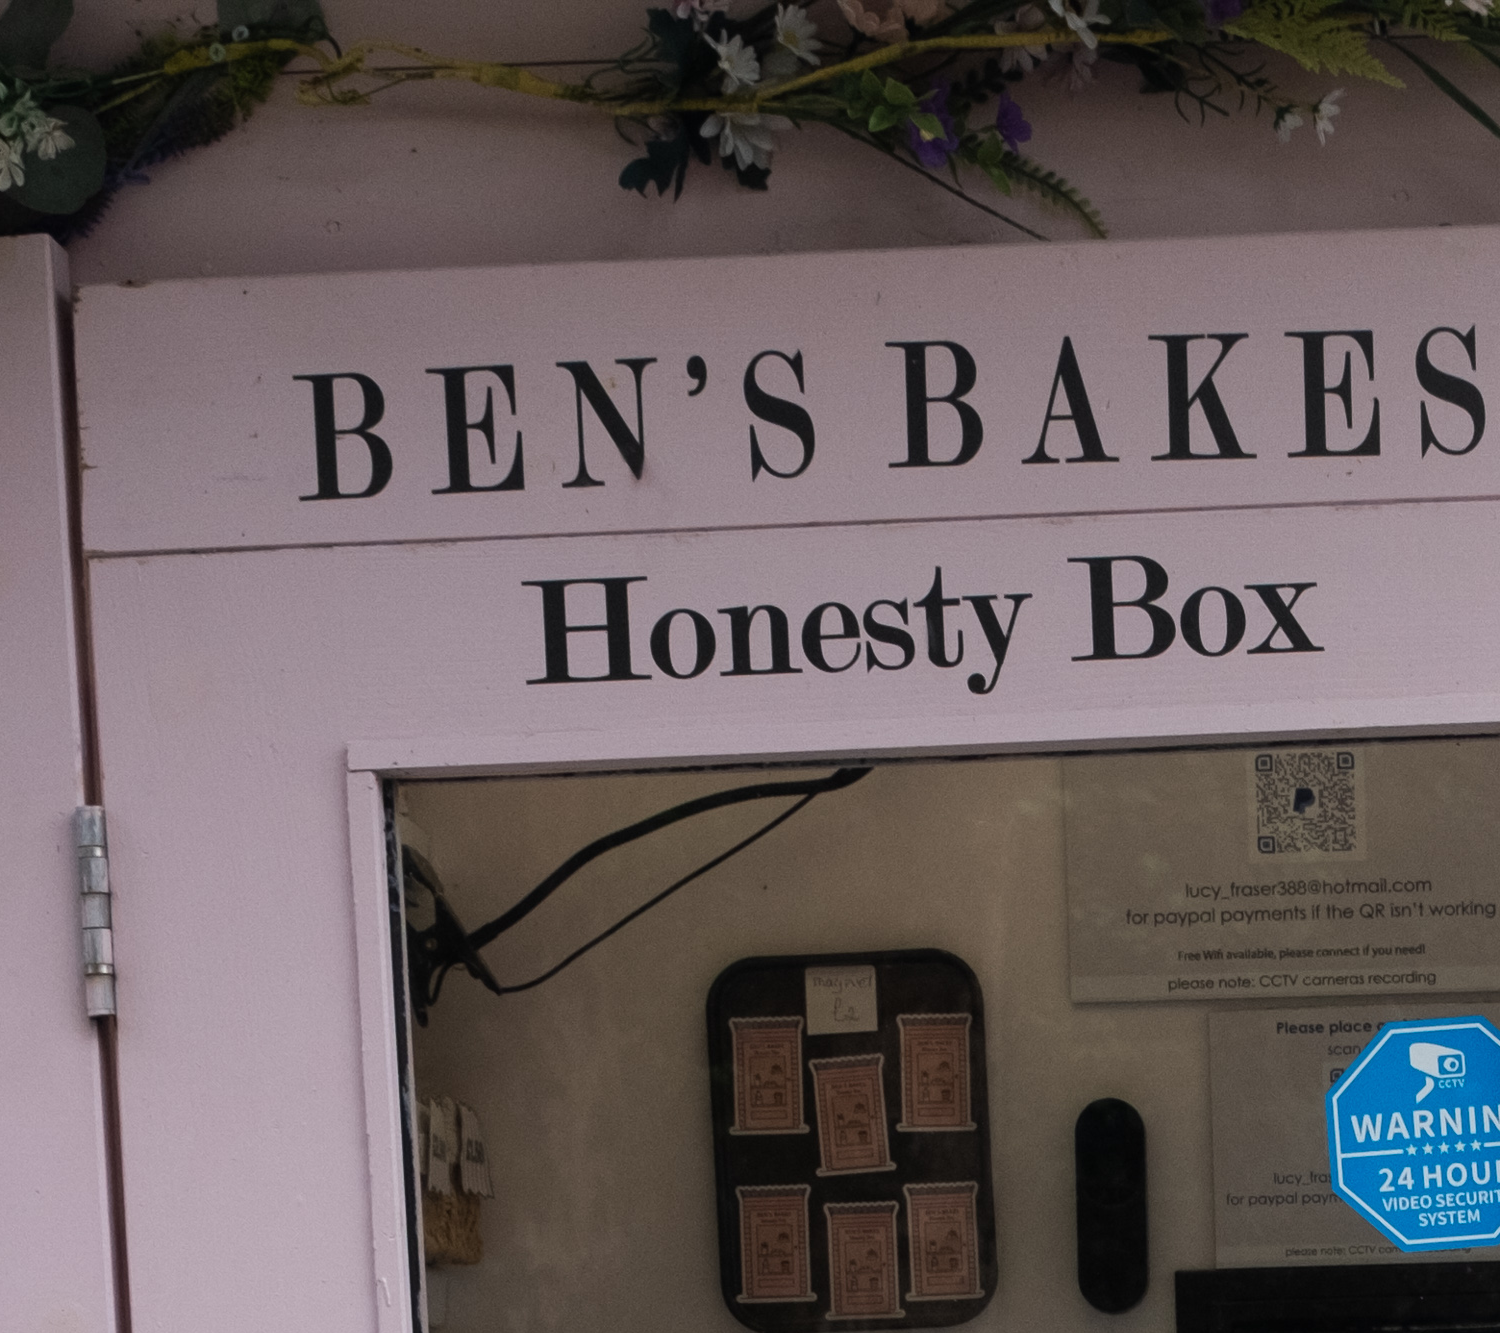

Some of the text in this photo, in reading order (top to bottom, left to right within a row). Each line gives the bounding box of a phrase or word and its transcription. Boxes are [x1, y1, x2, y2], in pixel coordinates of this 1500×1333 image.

[293, 324, 1488, 502] BEN'S BAKES
[521, 553, 1325, 695] Honesty Box
[1185, 877, 1432, 901] lucy_fraser388@hotmail.com
[1126, 901, 1496, 928] for paypal payments if the QR isn't working
[1177, 949, 1201, 961] Free
[1226, 947, 1277, 961] available,
[1279, 946, 1314, 961] please
[1316, 945, 1360, 958] connect
[1362, 944, 1371, 957] if
[1372, 946, 1393, 959] you
[1167, 970, 1437, 992] please note: CCTV cameras recording
[1276, 1022, 1324, 1036] Please
[1329, 1021, 1373, 1037] place
[1327, 1044, 1361, 1056] scan
[1438, 1078, 1465, 1089] CCTV
[1379, 1166, 1415, 1193] 24
[1226, 1193, 1245, 1206] for
[1248, 1191, 1298, 1208] paypal
[1382, 1194, 1433, 1212] VIDEO
[1418, 1208, 1481, 1227] SYSTEM
[1285, 1246, 1318, 1258] please
[1348, 1244, 1376, 1255] CCTV
